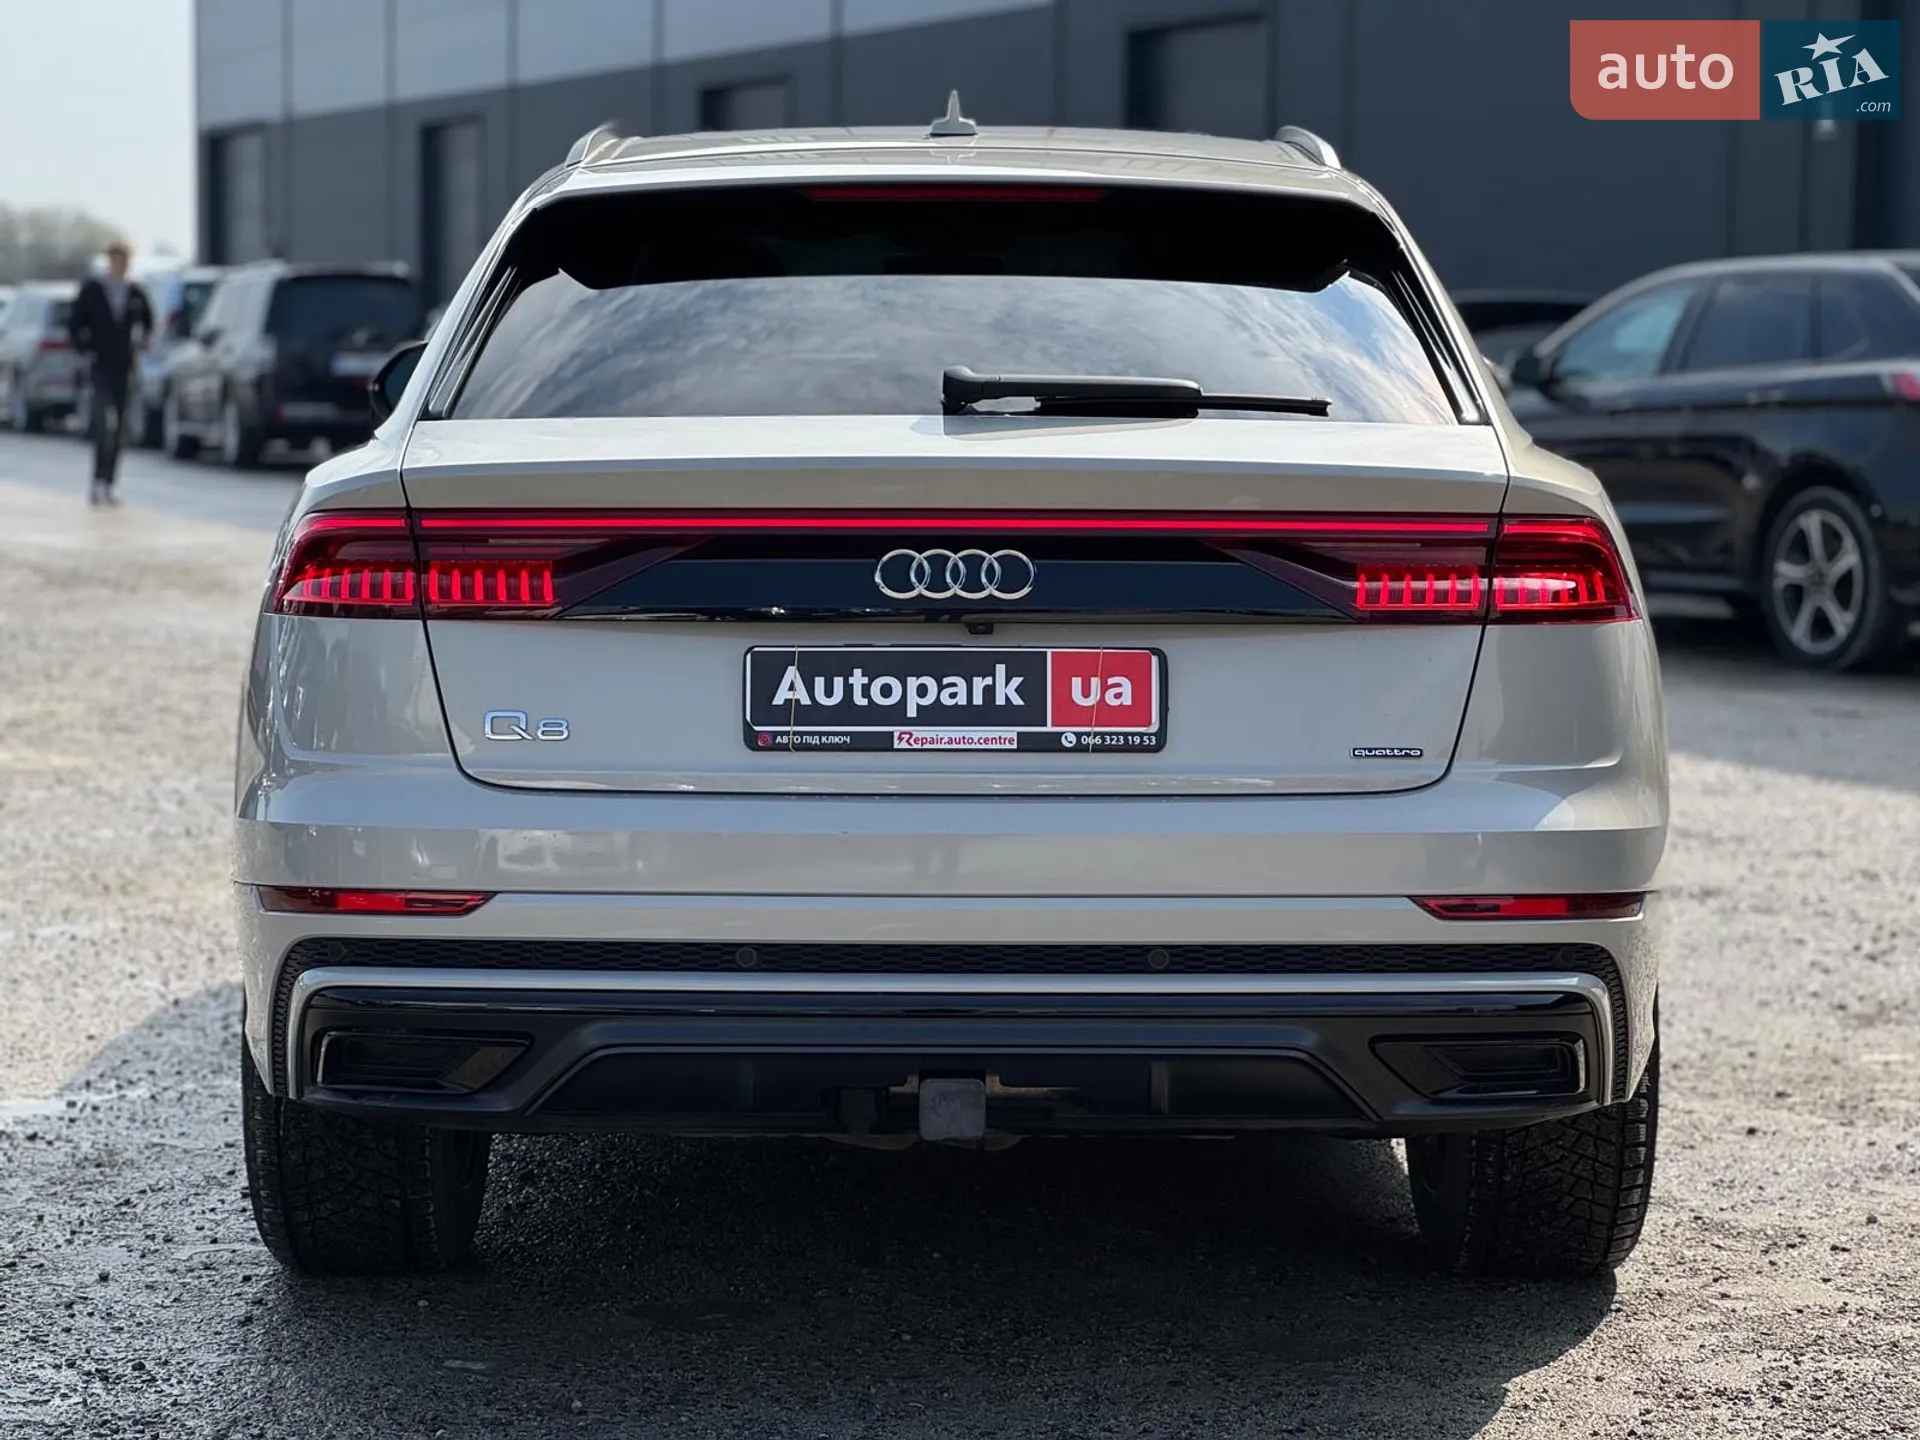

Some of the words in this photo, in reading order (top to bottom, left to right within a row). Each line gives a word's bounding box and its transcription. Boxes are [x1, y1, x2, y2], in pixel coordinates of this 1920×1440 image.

[772, 664, 1025, 718] Autopark
[1071, 675, 1132, 706] ua
[485, 711, 569, 741] Q8
[822, 735, 850, 744] КЛЮЧ
[1081, 735, 1102, 745] 066
[1104, 735, 1125, 745] 323
[1128, 735, 1141, 745] 19
[1143, 735, 1156, 745] 53
[1354, 748, 1421, 757] quattro
